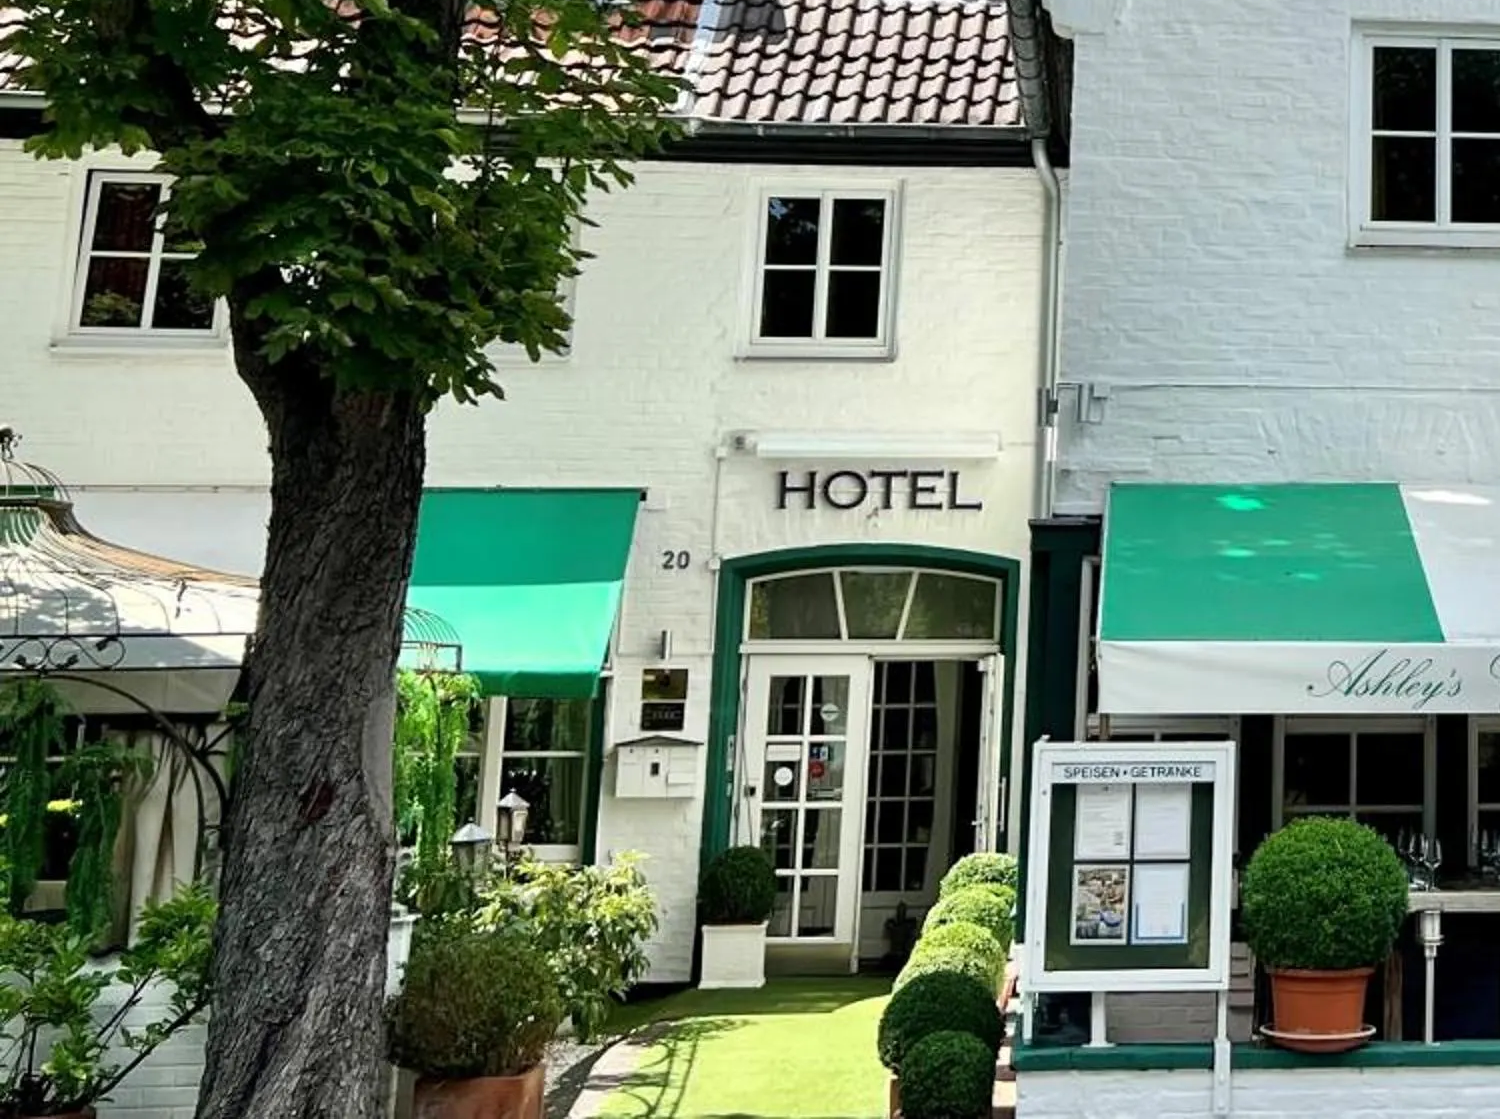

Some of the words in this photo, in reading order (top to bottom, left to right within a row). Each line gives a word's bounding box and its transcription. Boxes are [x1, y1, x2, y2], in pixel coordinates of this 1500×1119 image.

[776, 469, 983, 511] HOTEL
[661, 550, 691, 571] 20
[1306, 648, 1463, 710] Ashley's
[1063, 766, 1120, 779] SPEISEN
